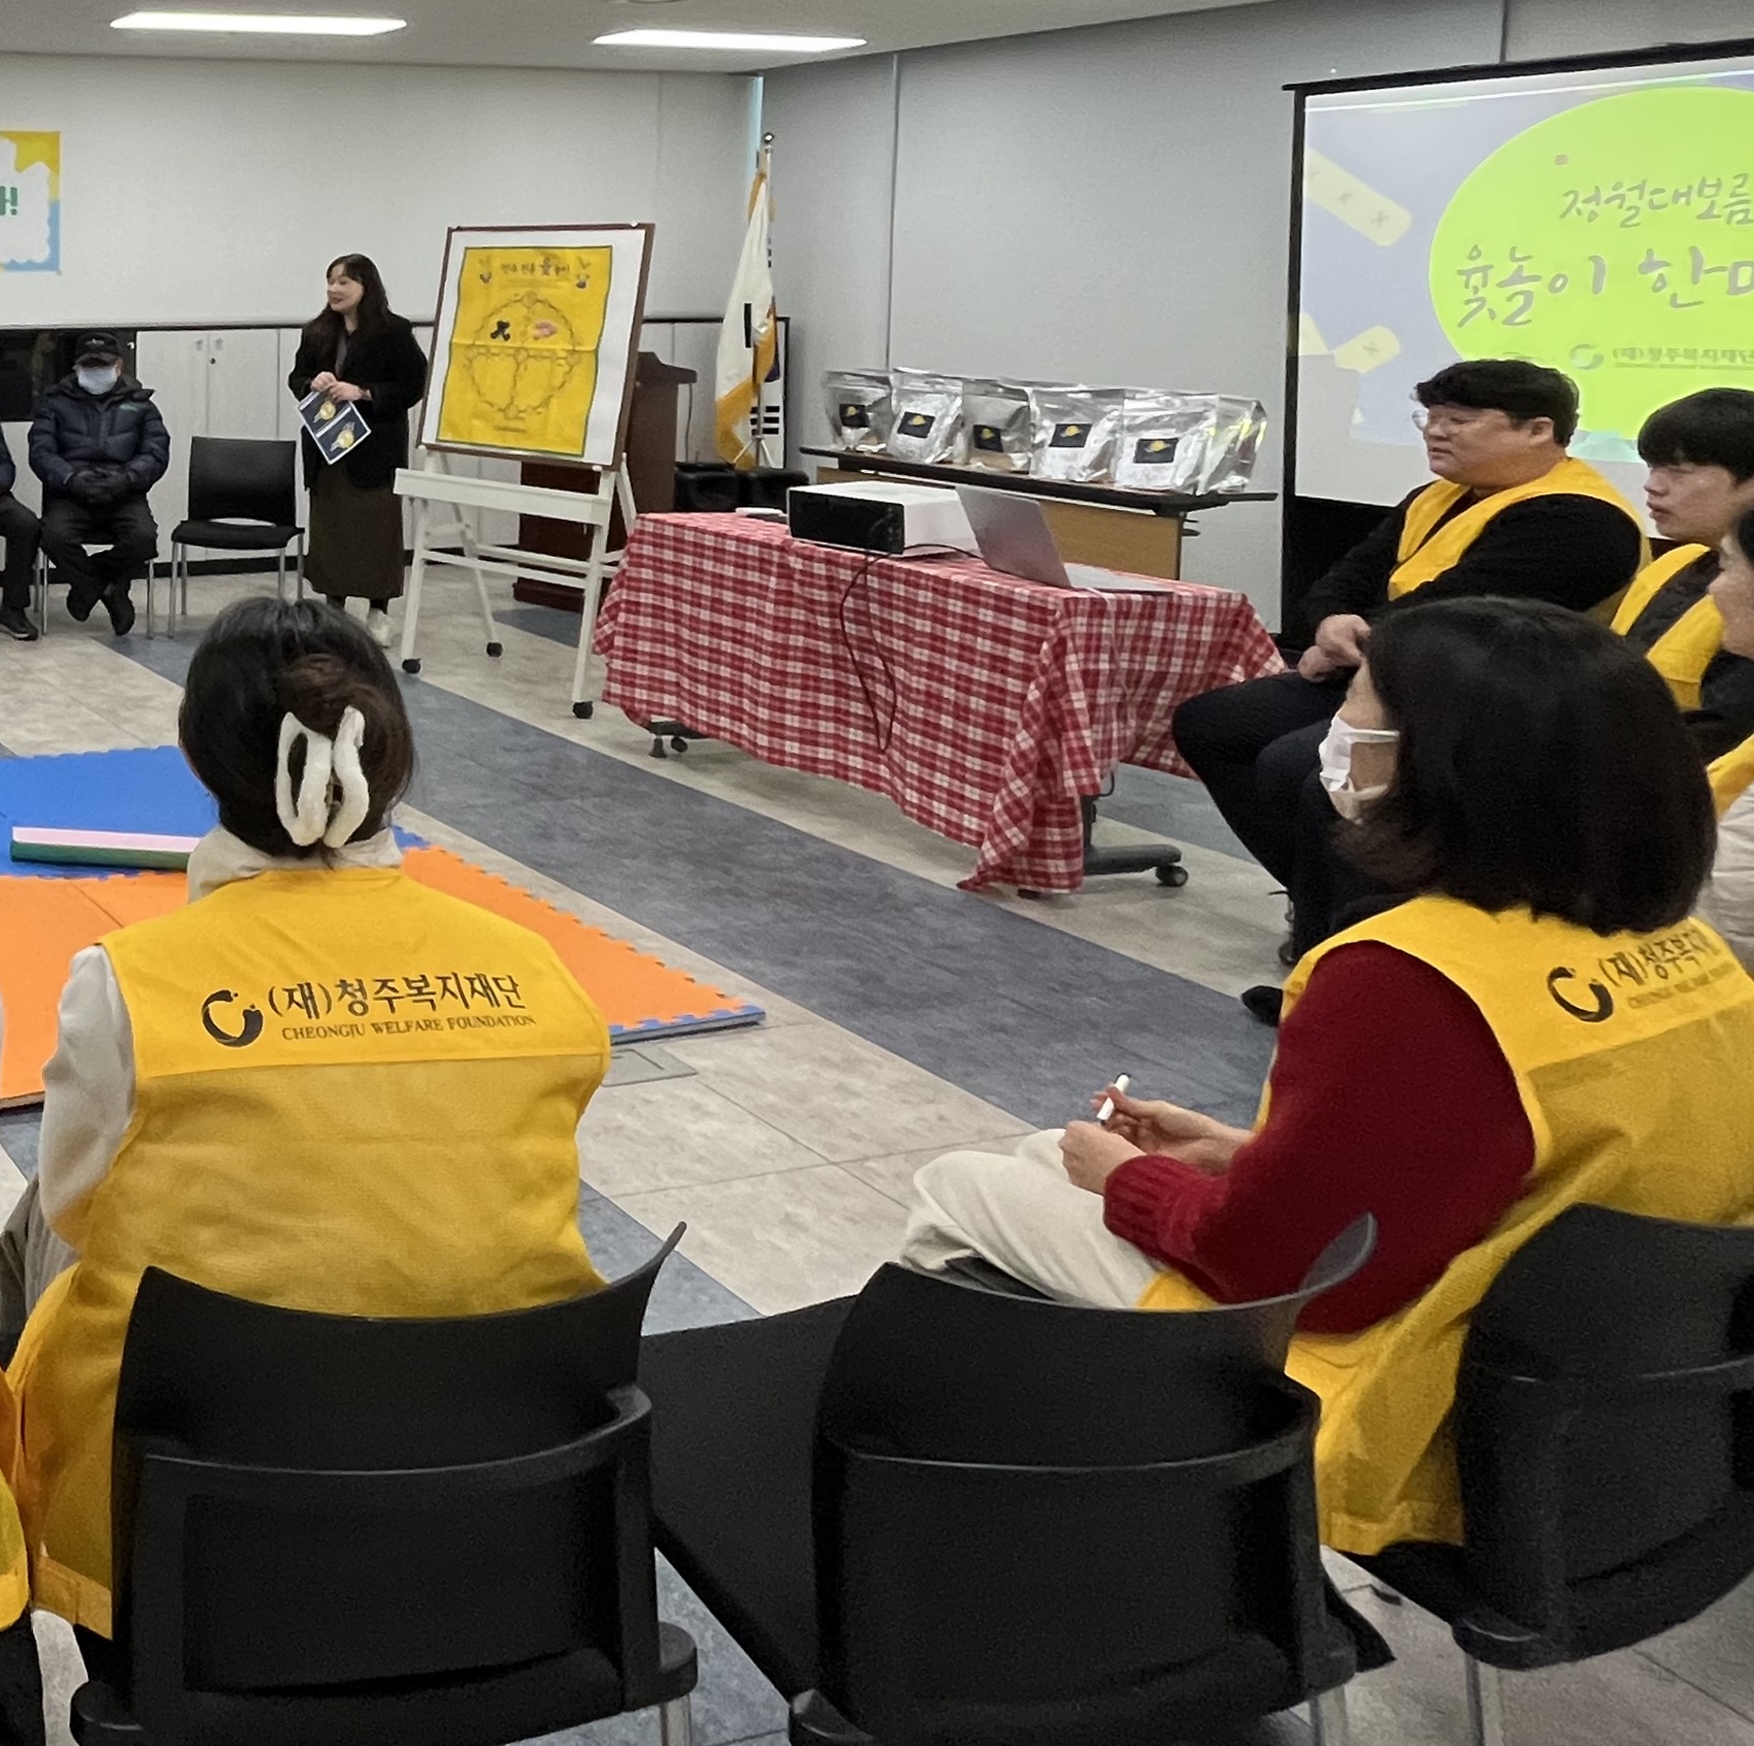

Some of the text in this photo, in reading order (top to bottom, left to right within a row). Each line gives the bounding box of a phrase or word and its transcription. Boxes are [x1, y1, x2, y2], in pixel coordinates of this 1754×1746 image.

[1559, 172, 1754, 229] 정월대보름
[1456, 243, 1608, 328] 윷놀이
[267, 971, 527, 1021] (재)청주복지재단
[281, 1014, 538, 1042] CHEONGJU WELFARE FOUNDATION
